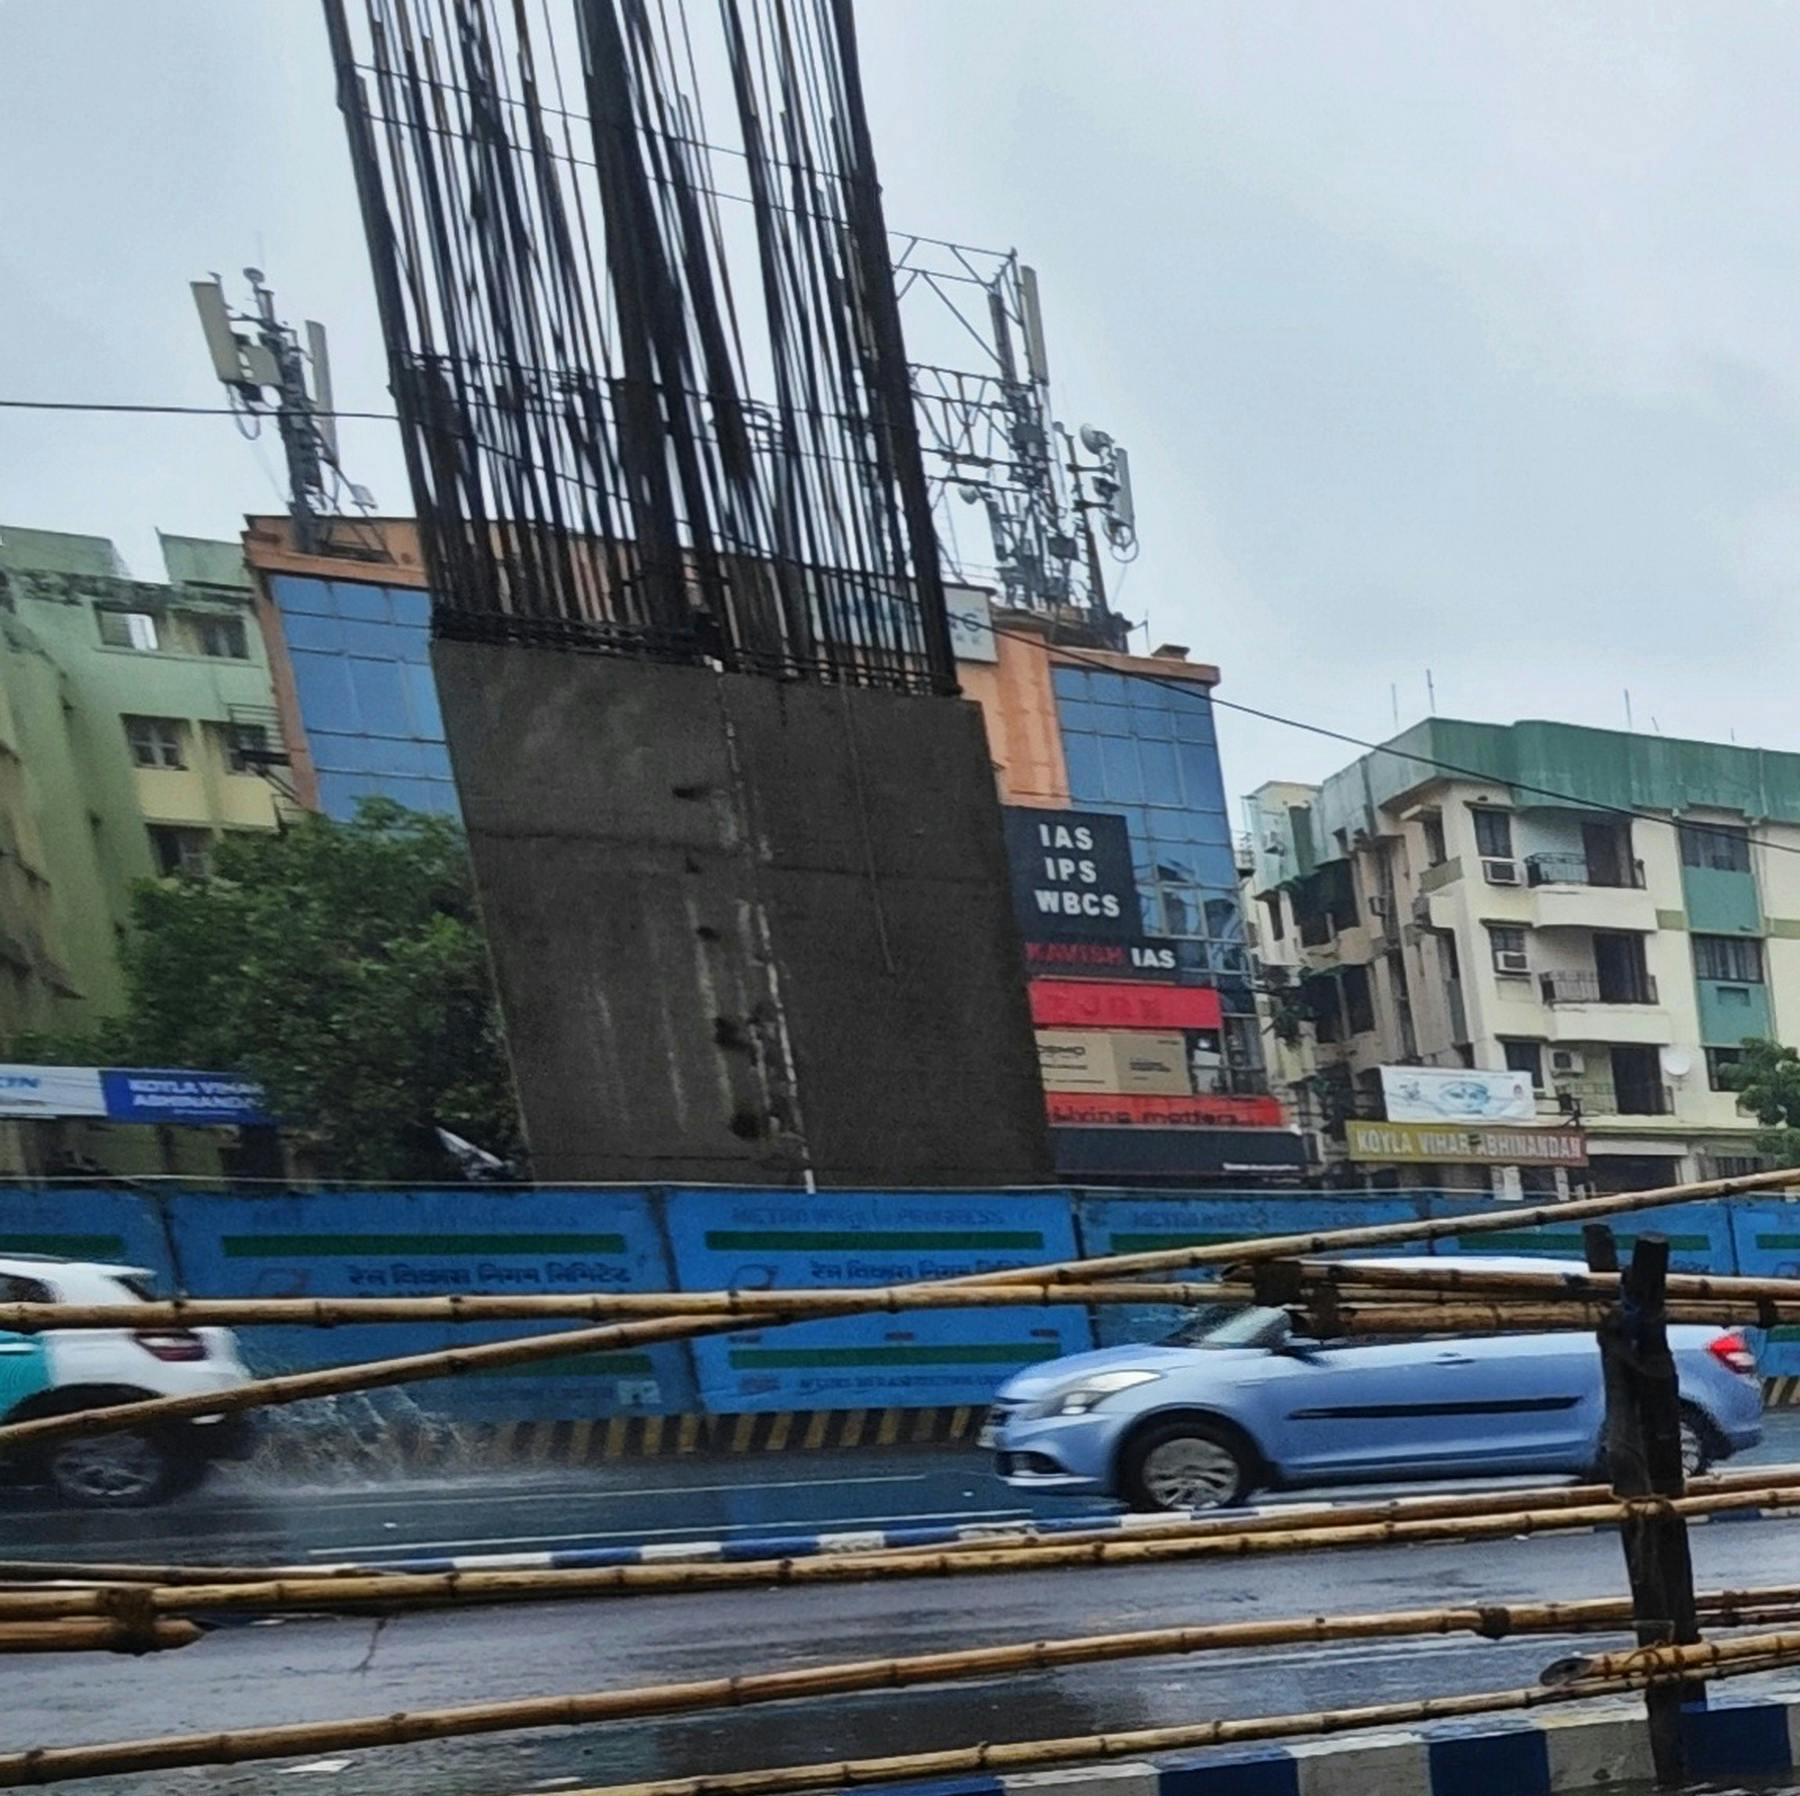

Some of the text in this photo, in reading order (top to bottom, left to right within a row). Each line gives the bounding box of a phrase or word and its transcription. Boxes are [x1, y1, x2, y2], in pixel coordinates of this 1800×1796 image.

[1039, 824, 1093, 850] IAS
[1045, 857, 1097, 883] IPS
[1034, 890, 1120, 917] WBCS
[1131, 948, 1176, 969] IAS
[1356, 1129, 1582, 1159] KOYLA VIHAR ABHINANDAN
